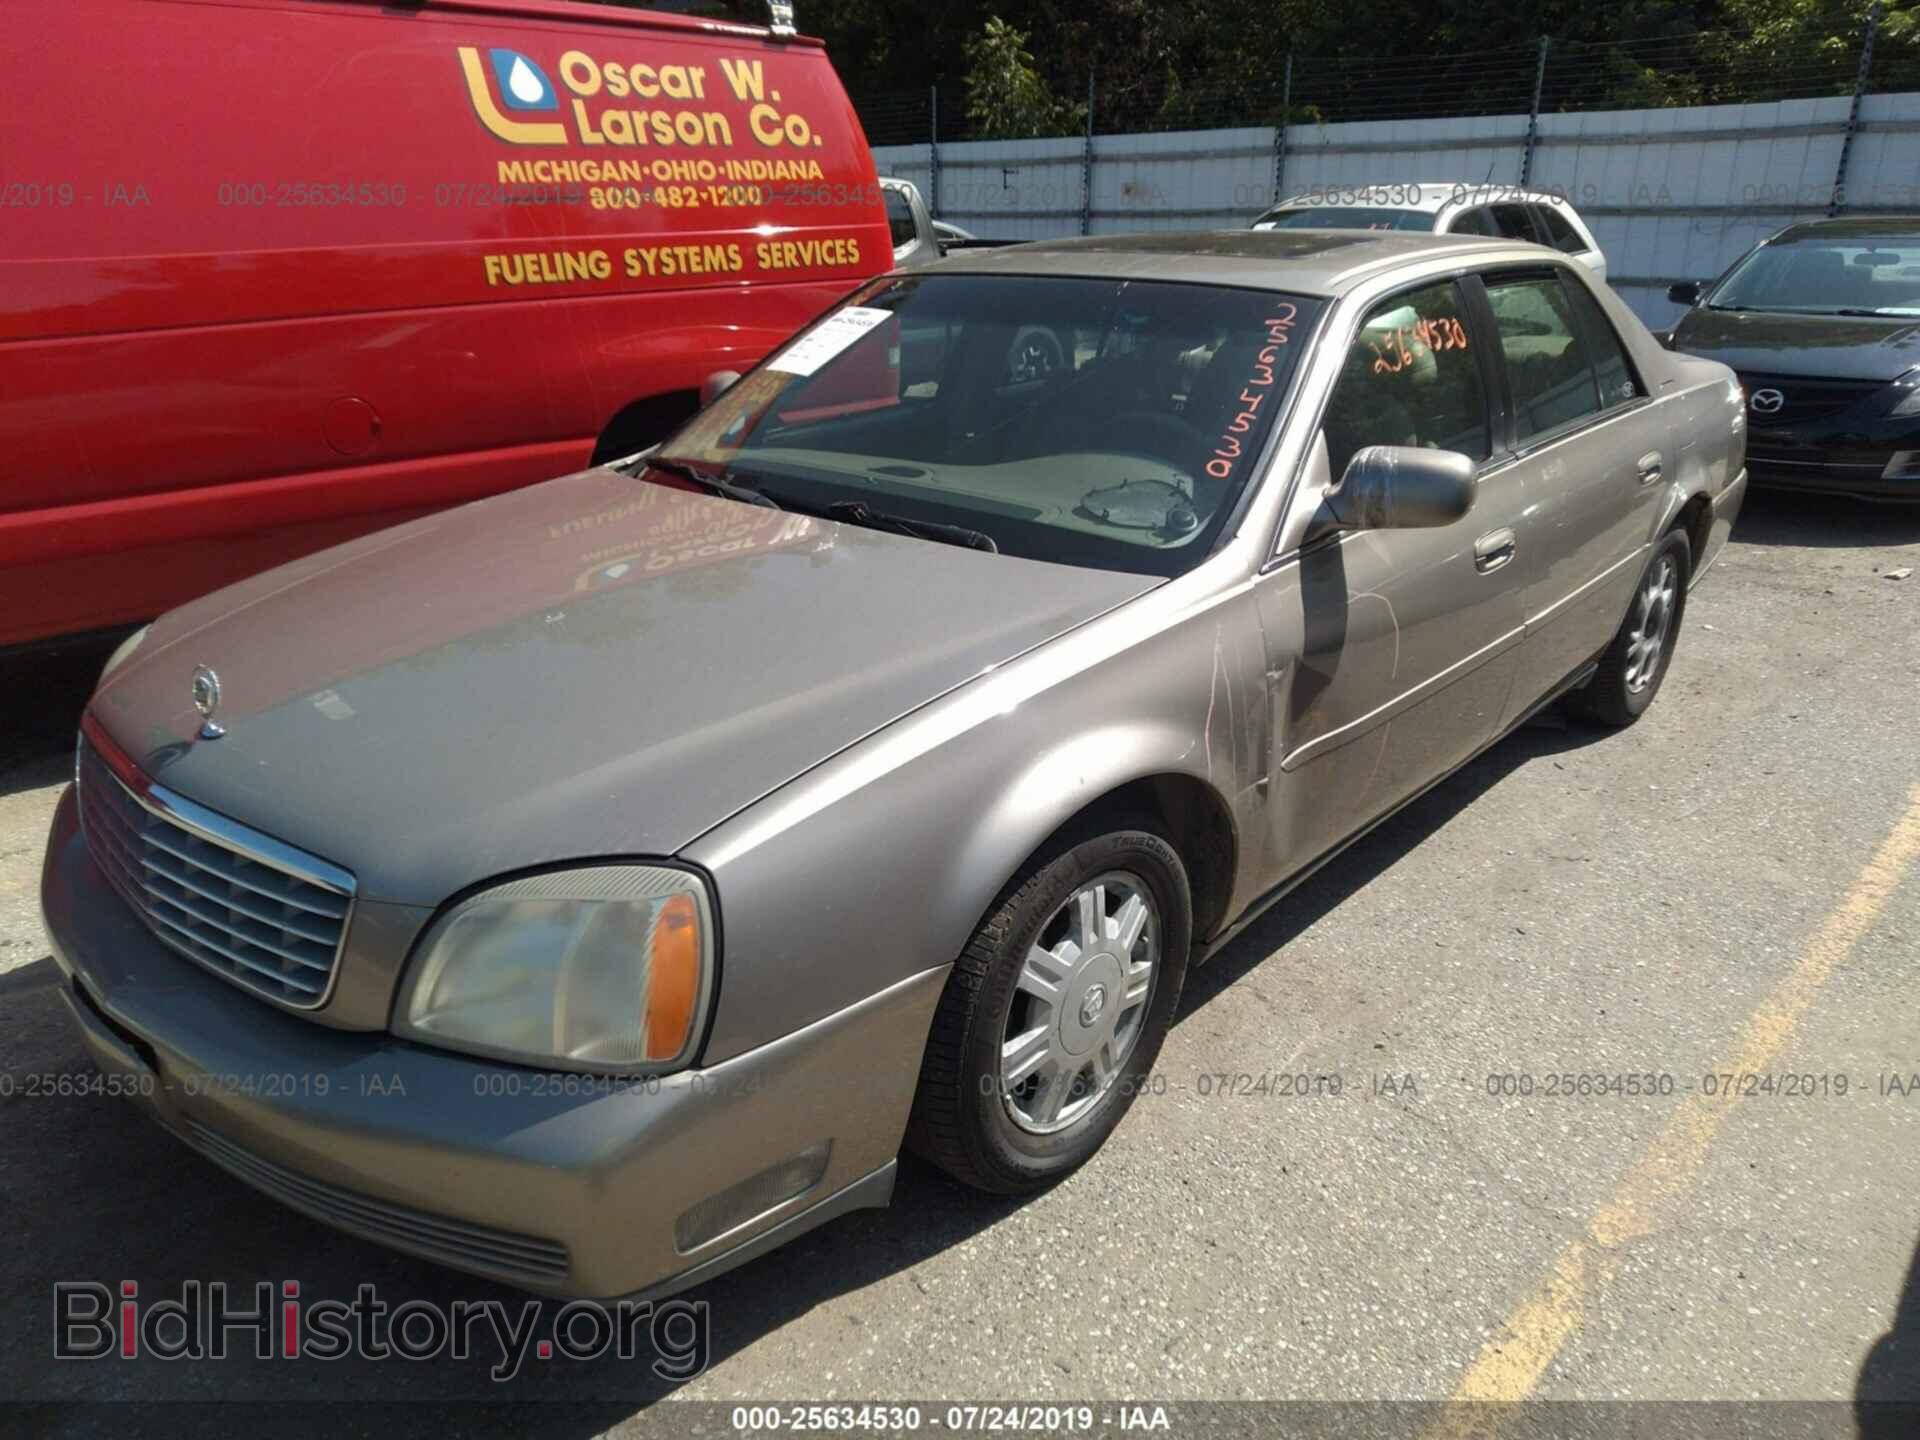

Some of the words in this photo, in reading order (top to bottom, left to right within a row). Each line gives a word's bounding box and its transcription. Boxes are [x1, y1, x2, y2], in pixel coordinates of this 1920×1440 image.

[559, 50, 706, 99] Oscar
[719, 58, 782, 102] W.
[570, 98, 733, 147] Larson
[750, 102, 823, 147] Co.
[483, 249, 613, 287] FUELING
[623, 243, 743, 278] SYSTEMS
[756, 238, 861, 271] SERVICES
